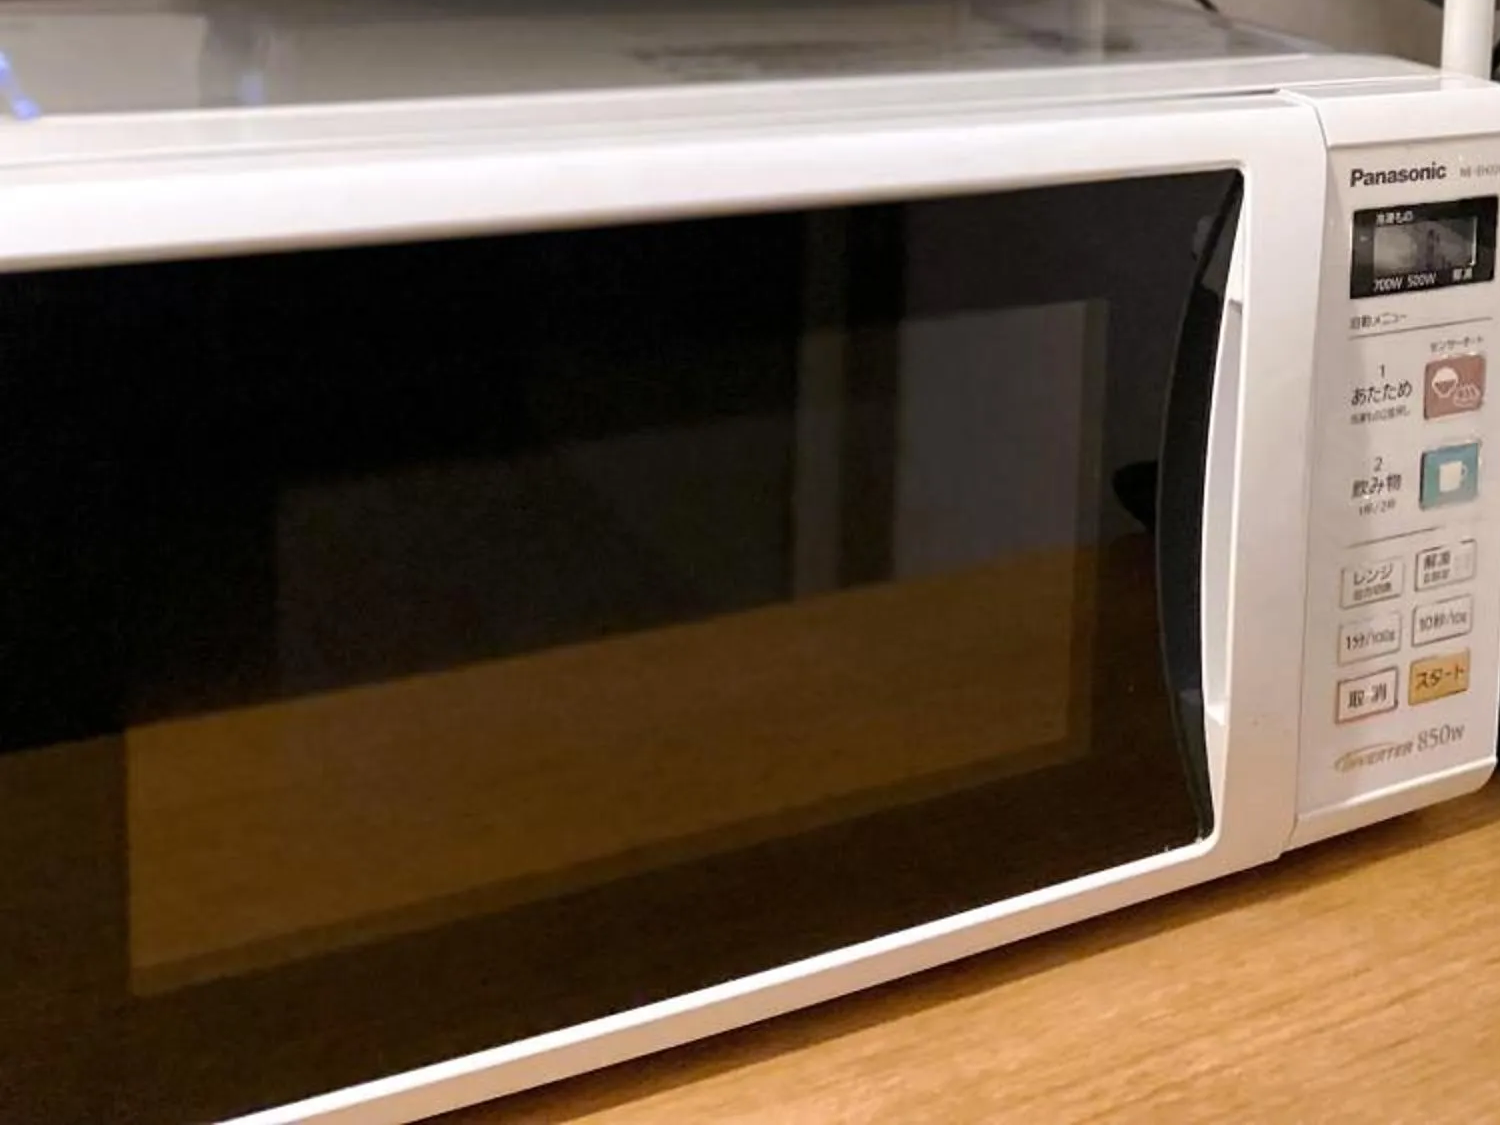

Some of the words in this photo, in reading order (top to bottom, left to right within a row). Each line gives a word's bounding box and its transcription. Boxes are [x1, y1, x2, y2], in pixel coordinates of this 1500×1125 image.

[1350, 161, 1448, 187] Panasonic
[1372, 277, 1403, 292] 700W
[1407, 273, 1437, 288] 500W
[1379, 364, 1386, 378] 1
[1351, 380, 1413, 407] あたため
[1373, 457, 1384, 473] 2
[1351, 474, 1402, 499] 飲み物
[1352, 562, 1395, 586] レンジ
[1415, 663, 1466, 690] スタート
